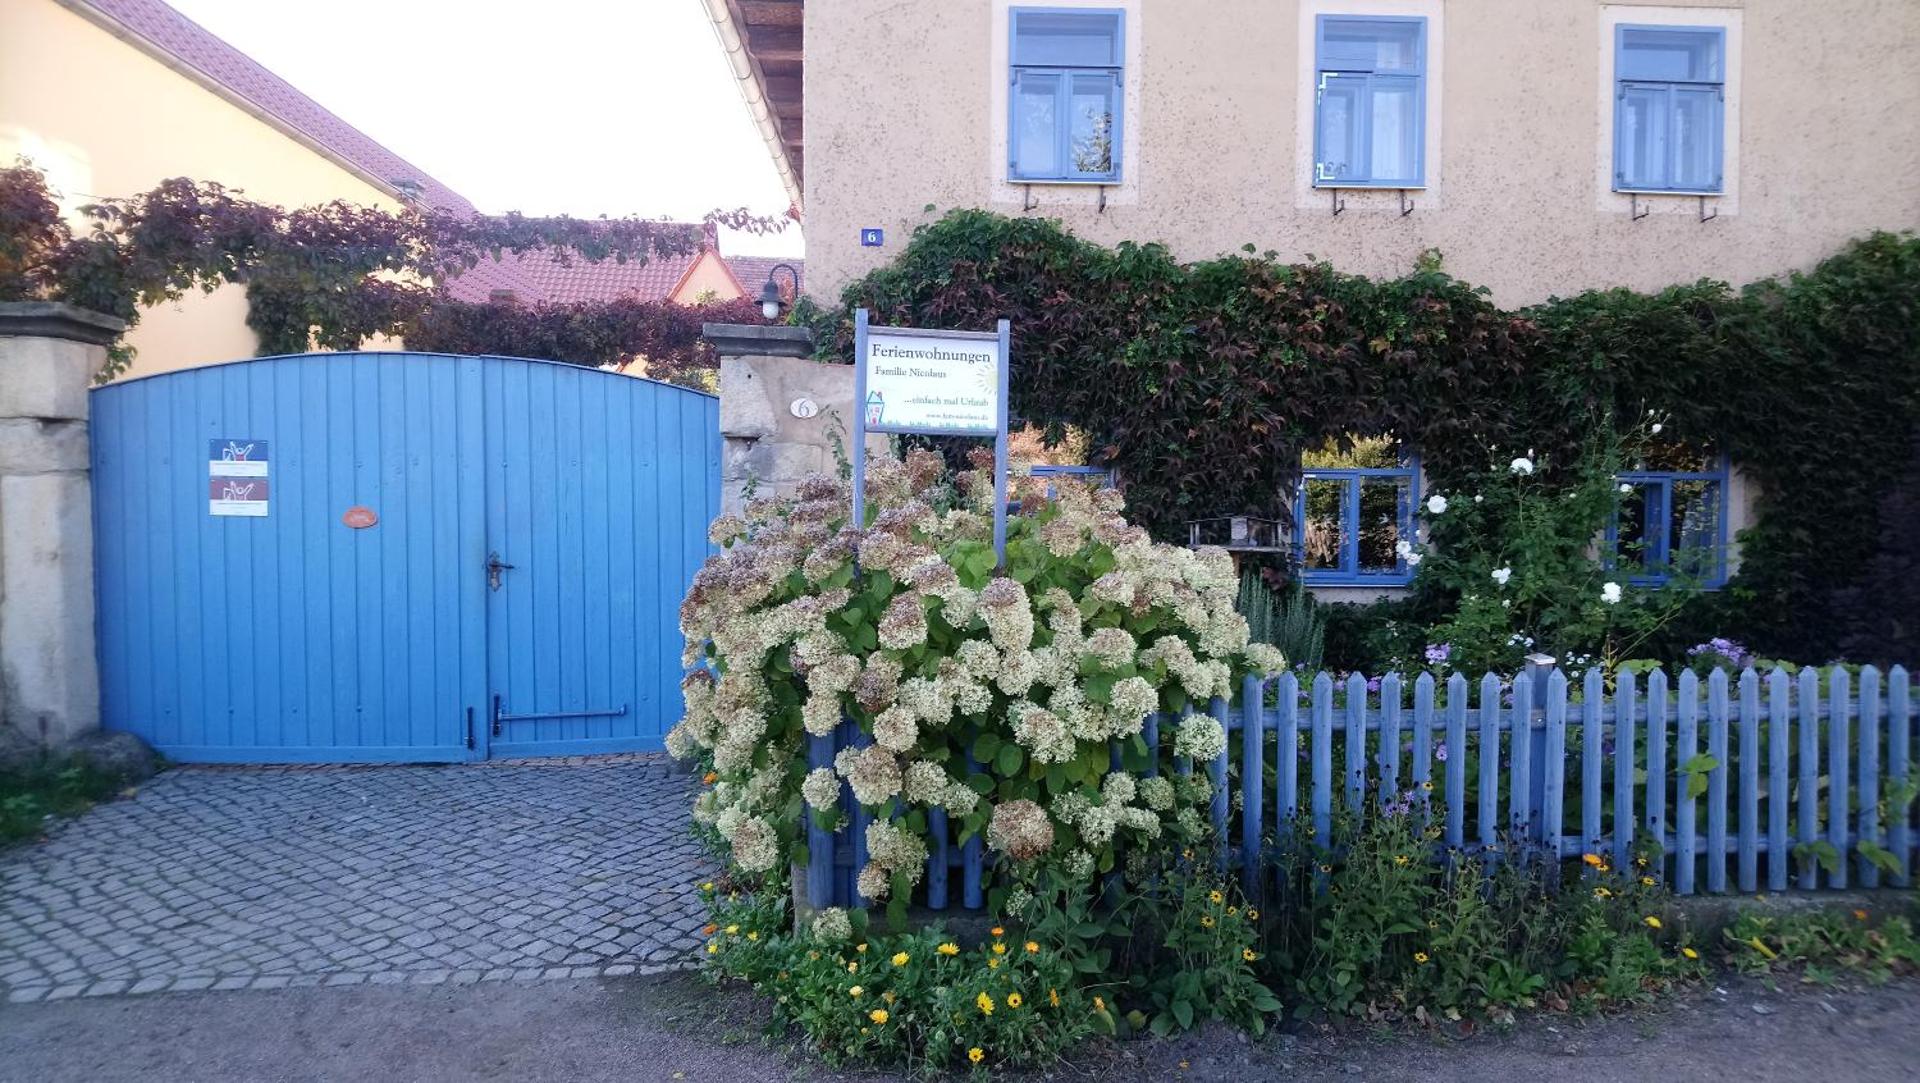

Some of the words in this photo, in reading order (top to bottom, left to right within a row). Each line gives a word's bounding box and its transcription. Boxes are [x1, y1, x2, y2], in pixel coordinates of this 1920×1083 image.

[867, 231, 876, 243] 6
[872, 343, 991, 364] Ferienwohnungen
[875, 365, 907, 376] Familie
[943, 396, 959, 406] mal
[960, 397, 989, 407] Urlaub
[798, 400, 810, 417] 6
